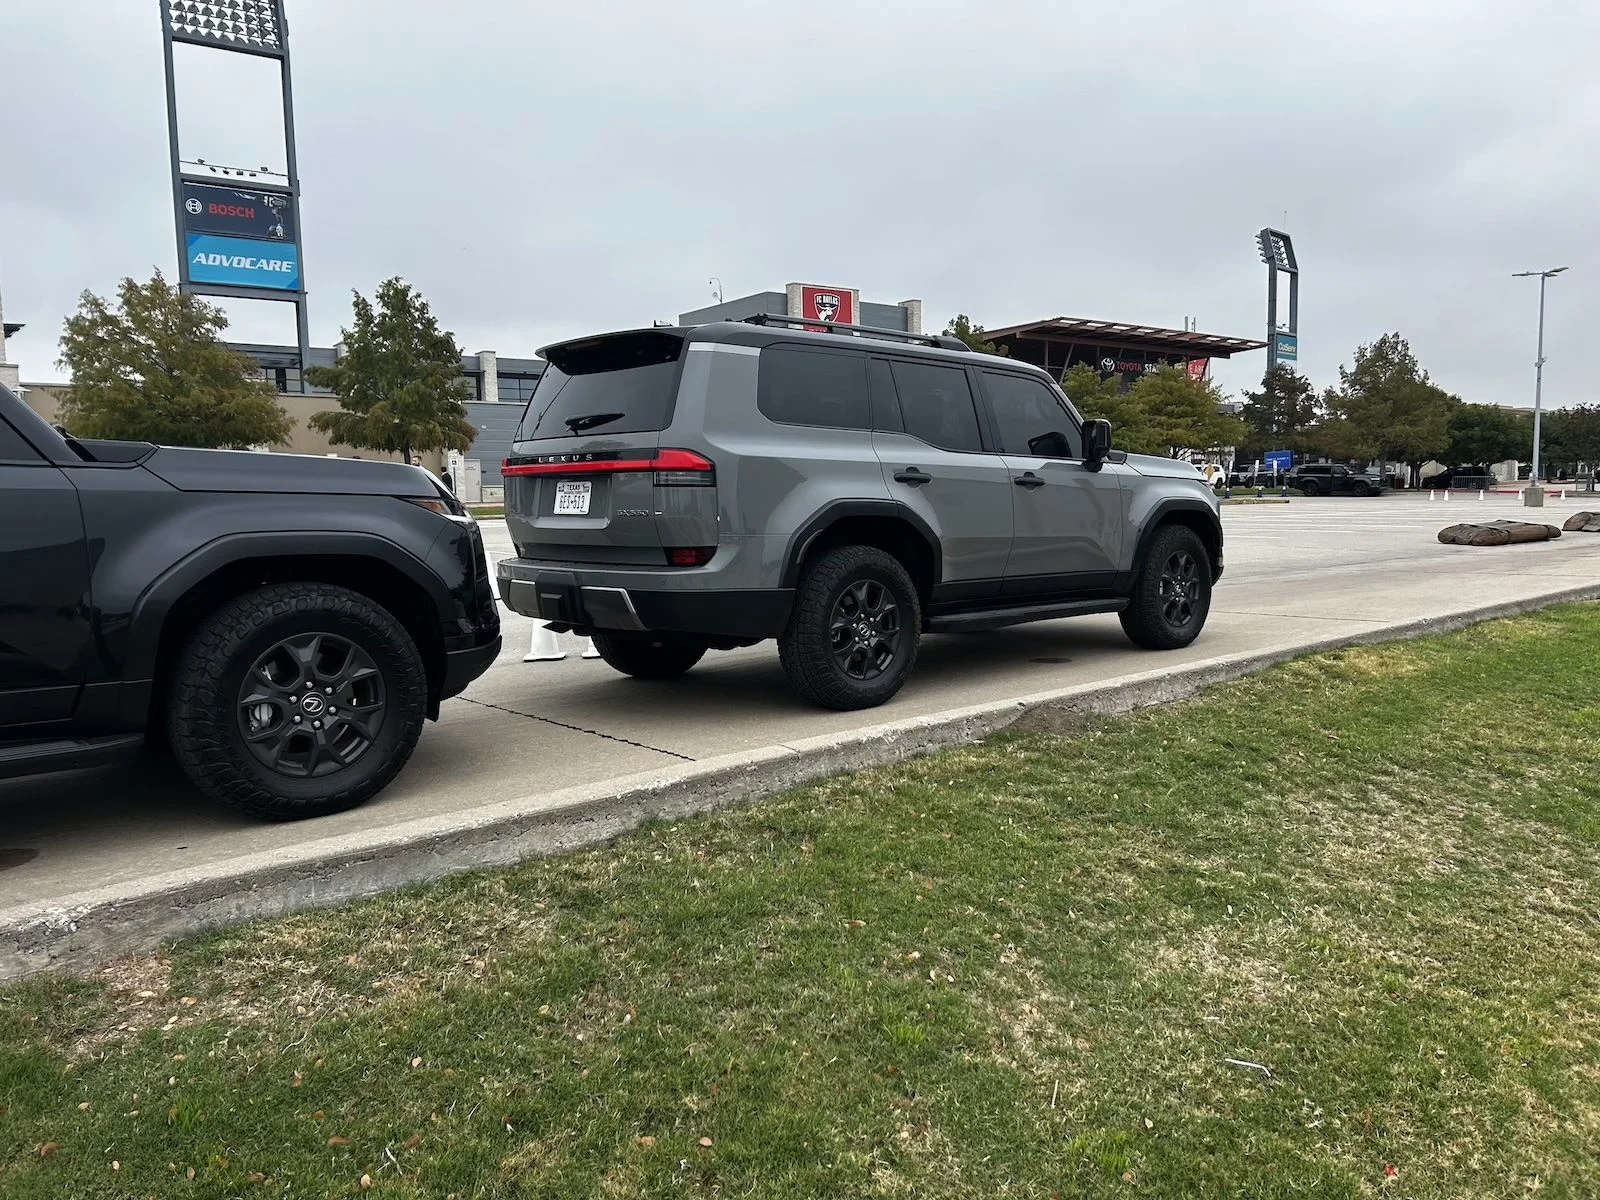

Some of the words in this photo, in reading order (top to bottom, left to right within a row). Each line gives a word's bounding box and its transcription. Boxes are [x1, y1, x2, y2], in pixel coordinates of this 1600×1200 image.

[208, 202, 256, 218] BOSCH
[192, 252, 294, 273] ADVOCARE
[1116, 361, 1142, 372] TOYOTA
[538, 454, 593, 463] LEXUS
